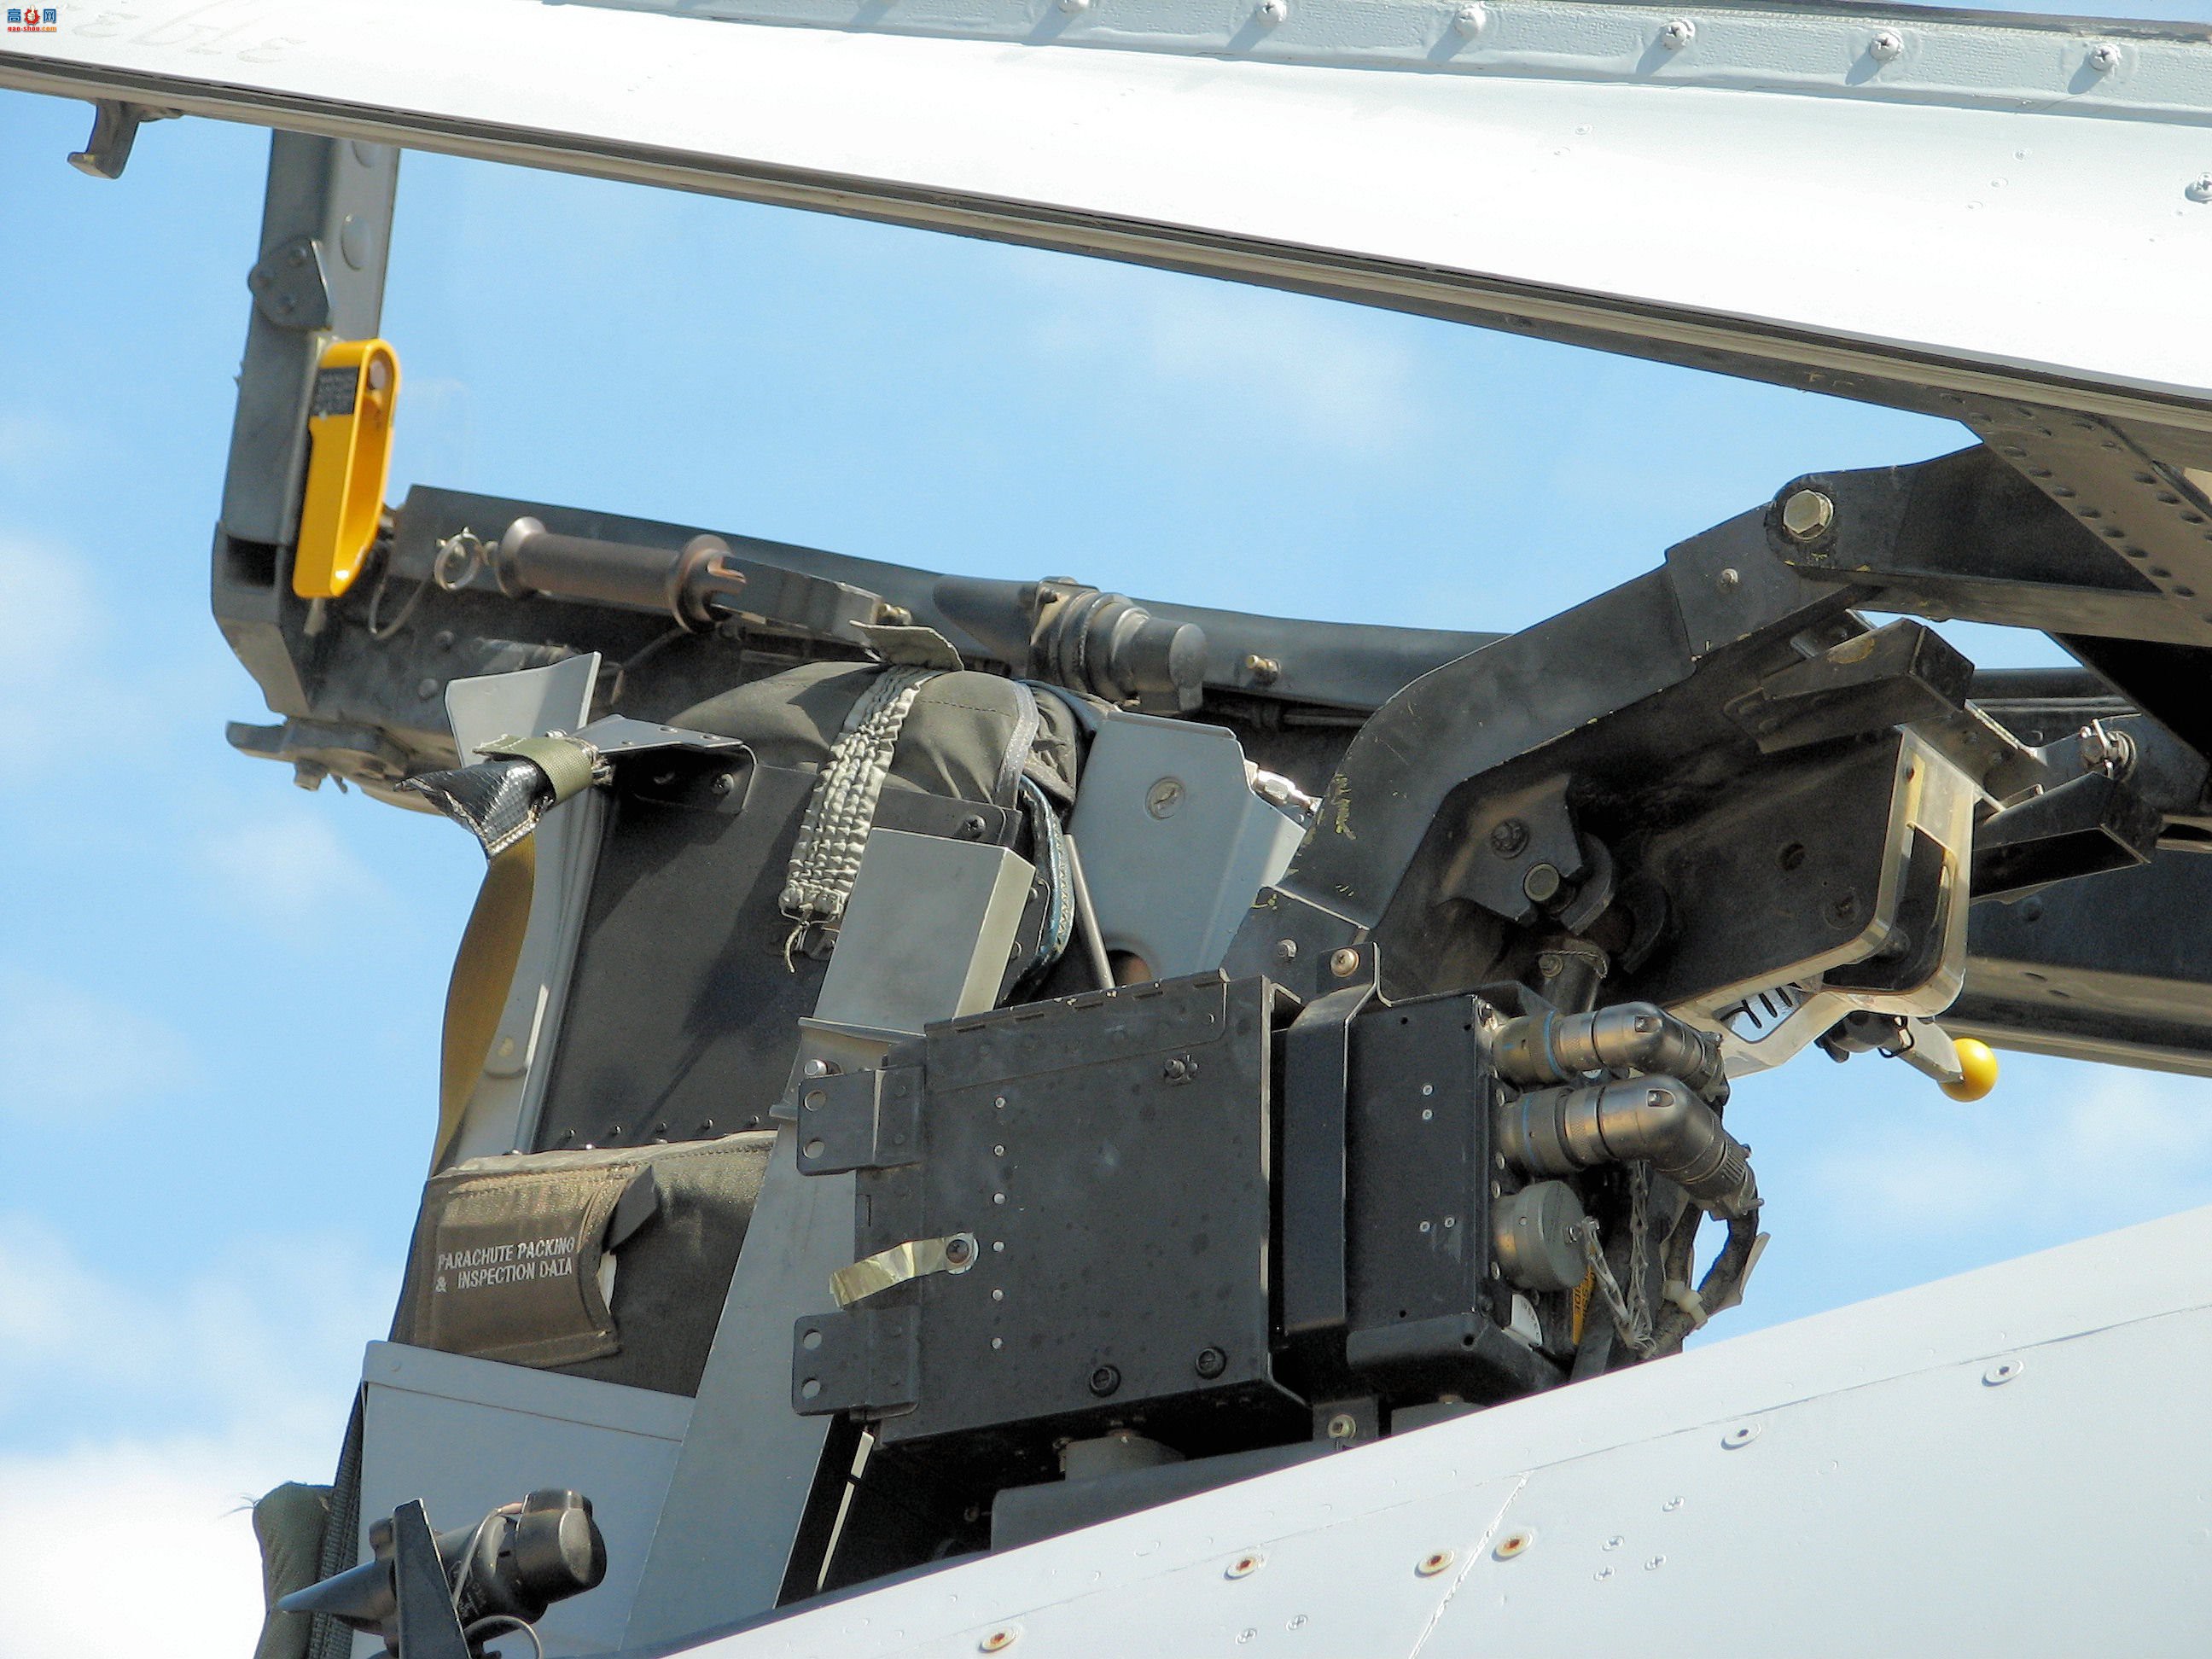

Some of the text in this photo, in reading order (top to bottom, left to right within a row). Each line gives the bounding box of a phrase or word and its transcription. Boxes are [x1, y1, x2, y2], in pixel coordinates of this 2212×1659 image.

[436, 1236, 575, 1272] PARACHUTE PACKING
[435, 1257, 573, 1293] & INSPECTION DATA
